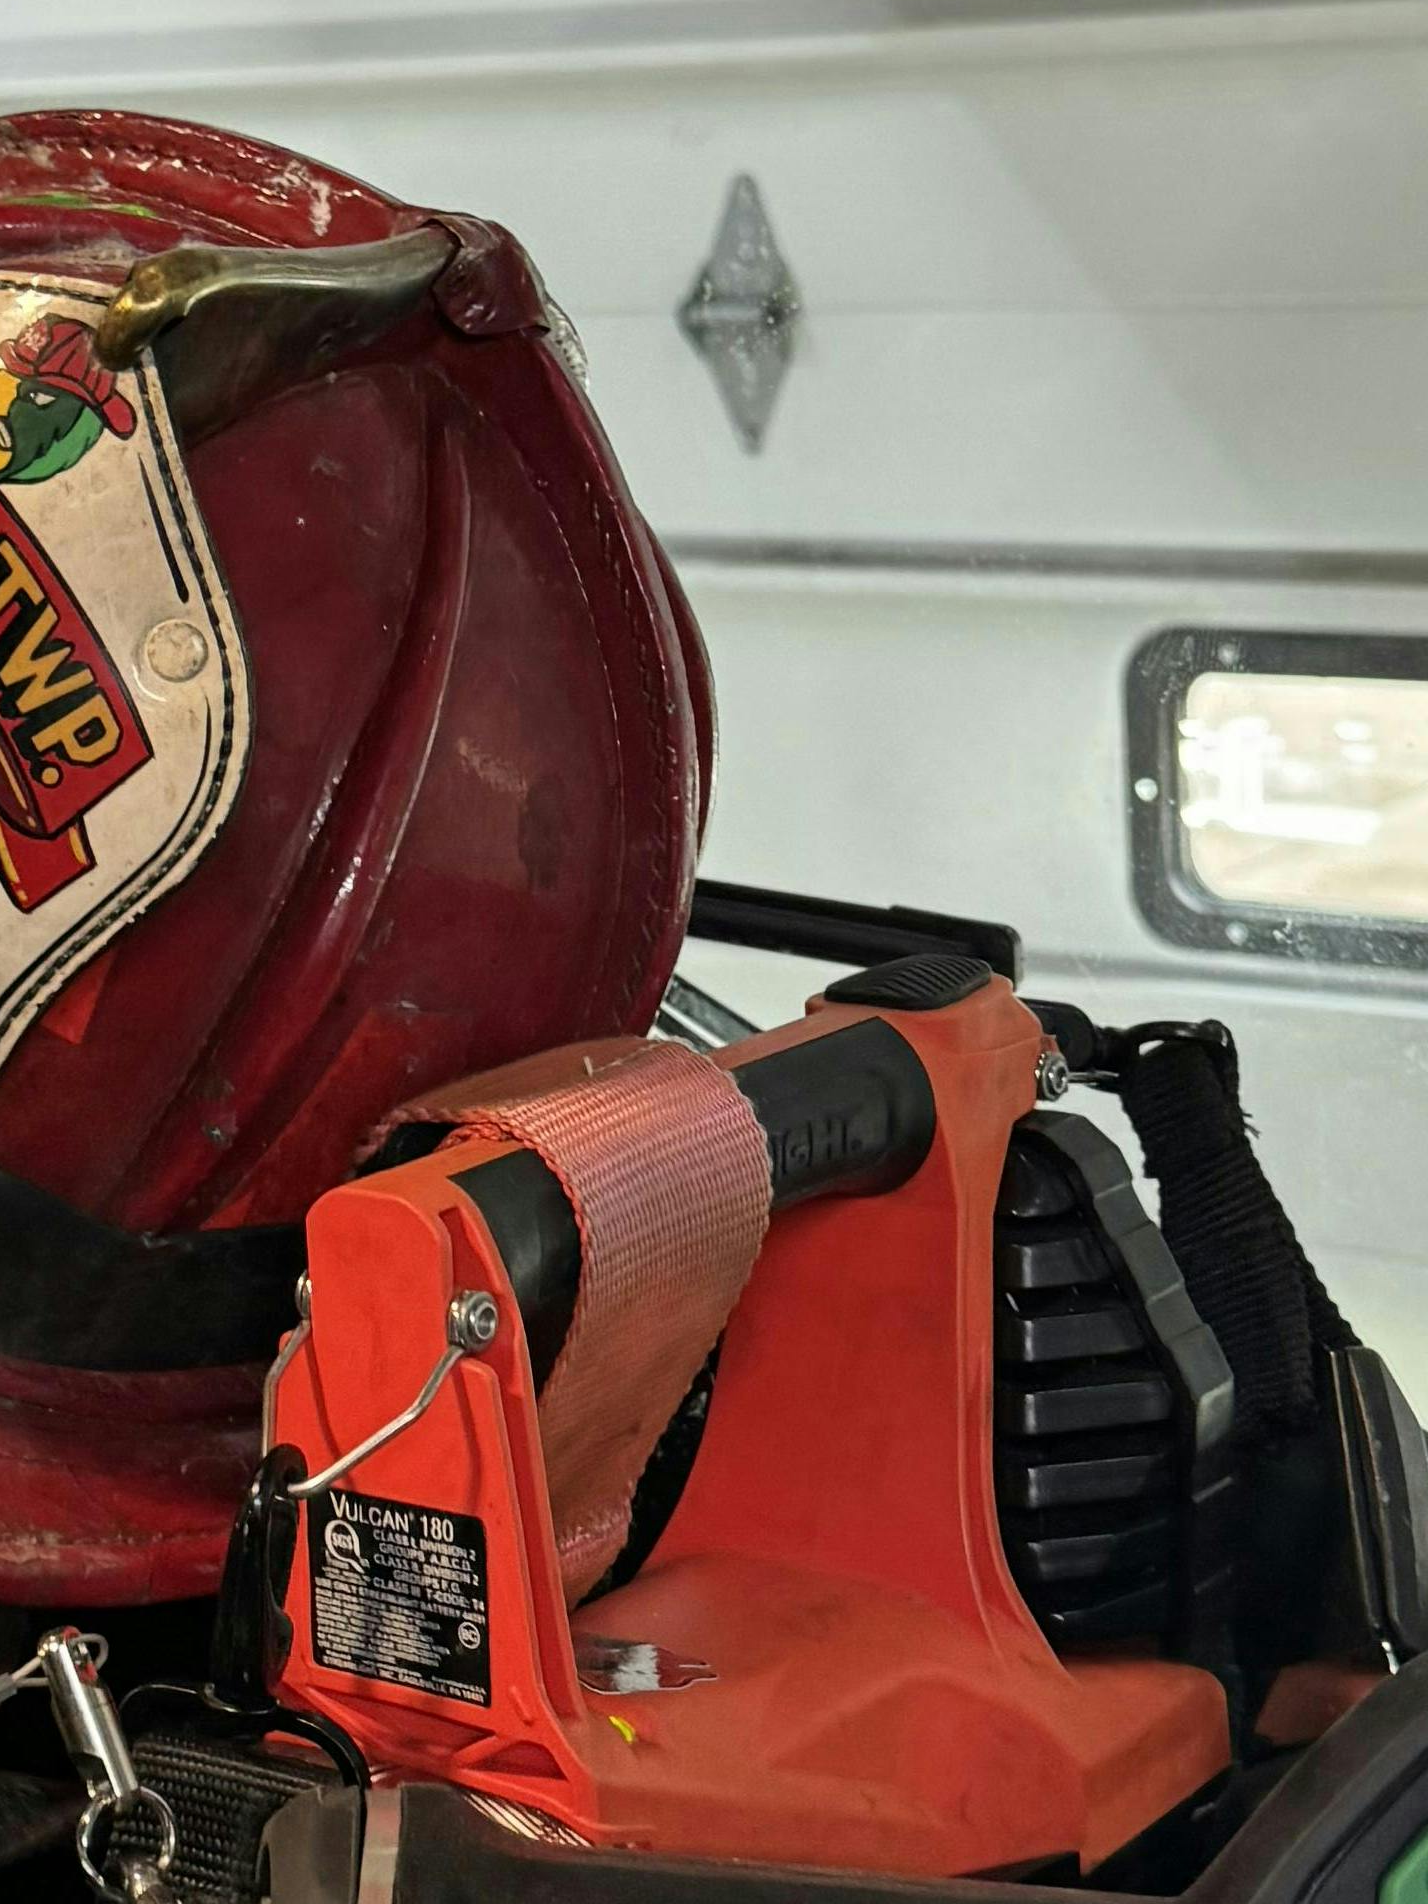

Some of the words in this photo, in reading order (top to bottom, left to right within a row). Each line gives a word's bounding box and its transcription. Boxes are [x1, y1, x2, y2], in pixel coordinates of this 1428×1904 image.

[421, 1515, 454, 1543] 180
[373, 1529, 407, 1546] CLASS
[420, 1539, 467, 1559] DIVISION
[469, 1549, 476, 1561] 2
[379, 1542, 425, 1562] GROUPS
[374, 1553, 410, 1571] CLASS
[423, 1564, 470, 1584] DIVISION
[472, 1575, 479, 1586] 2
[393, 1569, 439, 1589] GROUPS
[373, 1577, 408, 1595] CLASS
